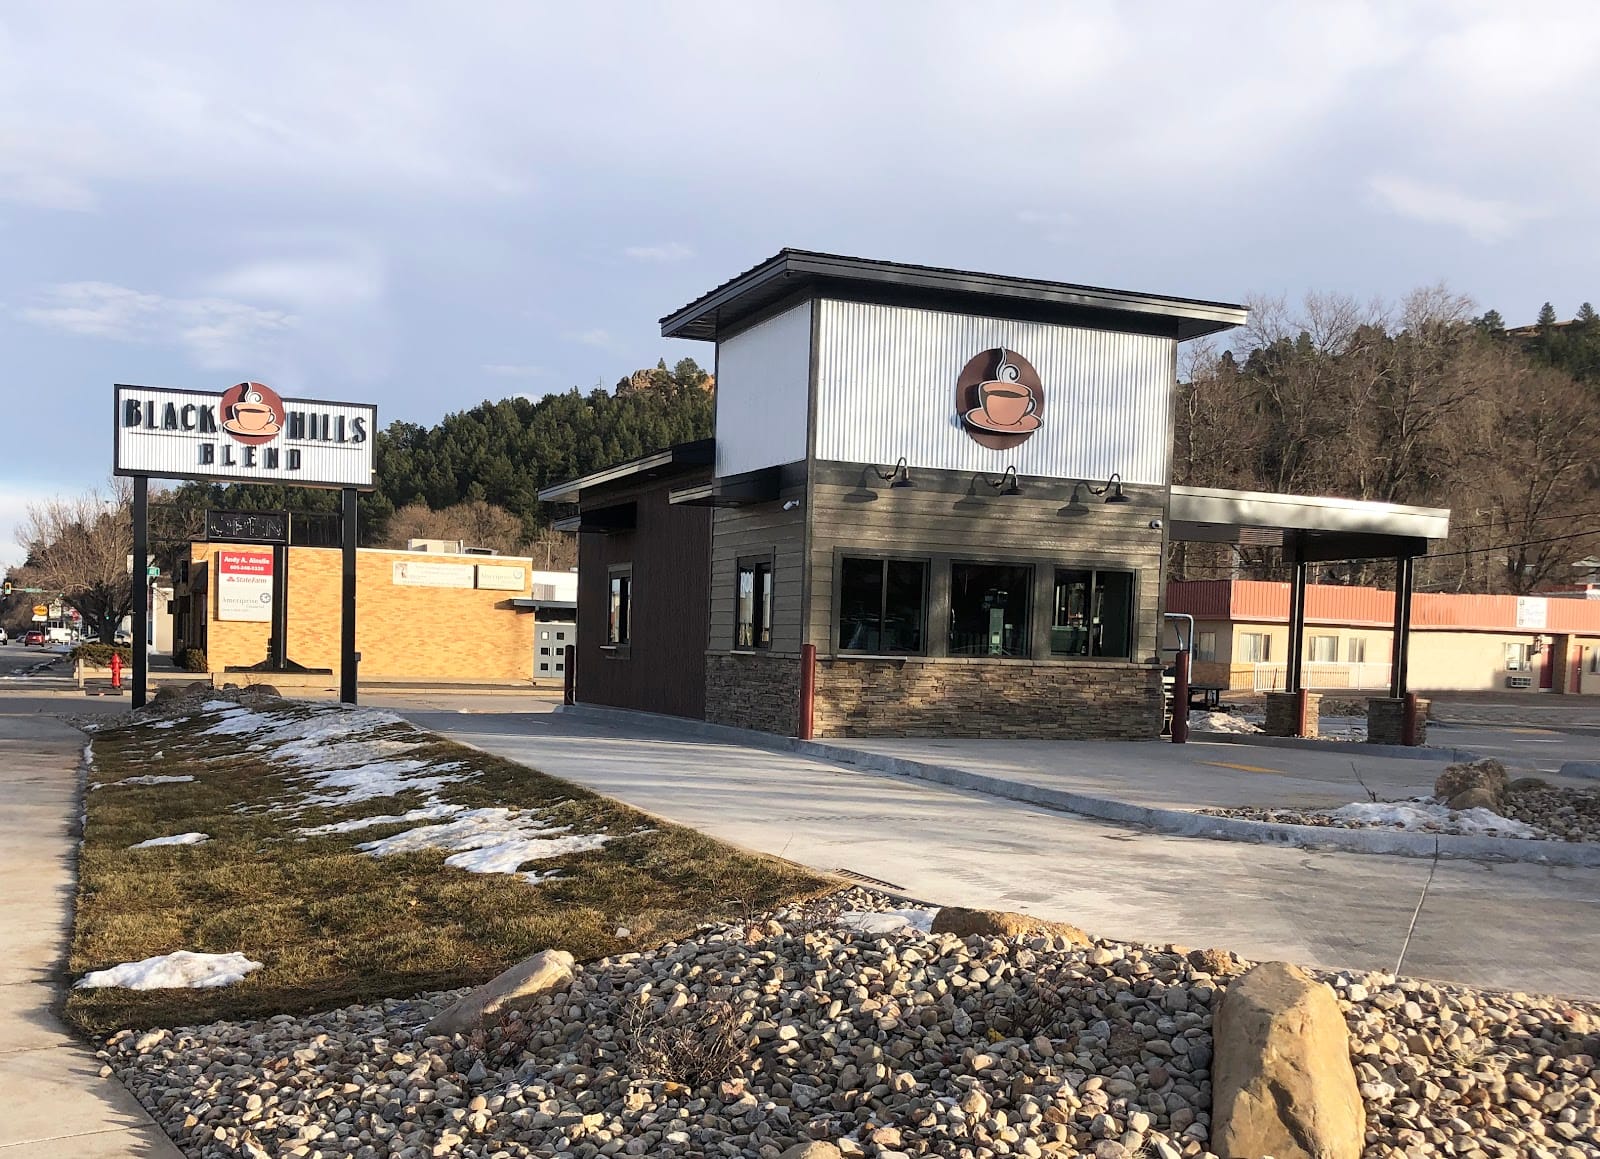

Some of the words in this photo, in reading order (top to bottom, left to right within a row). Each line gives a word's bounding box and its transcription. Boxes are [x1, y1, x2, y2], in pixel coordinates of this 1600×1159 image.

[123, 398, 217, 434] BLACK
[286, 411, 367, 444] HILLS
[199, 443, 301, 471] BLEND
